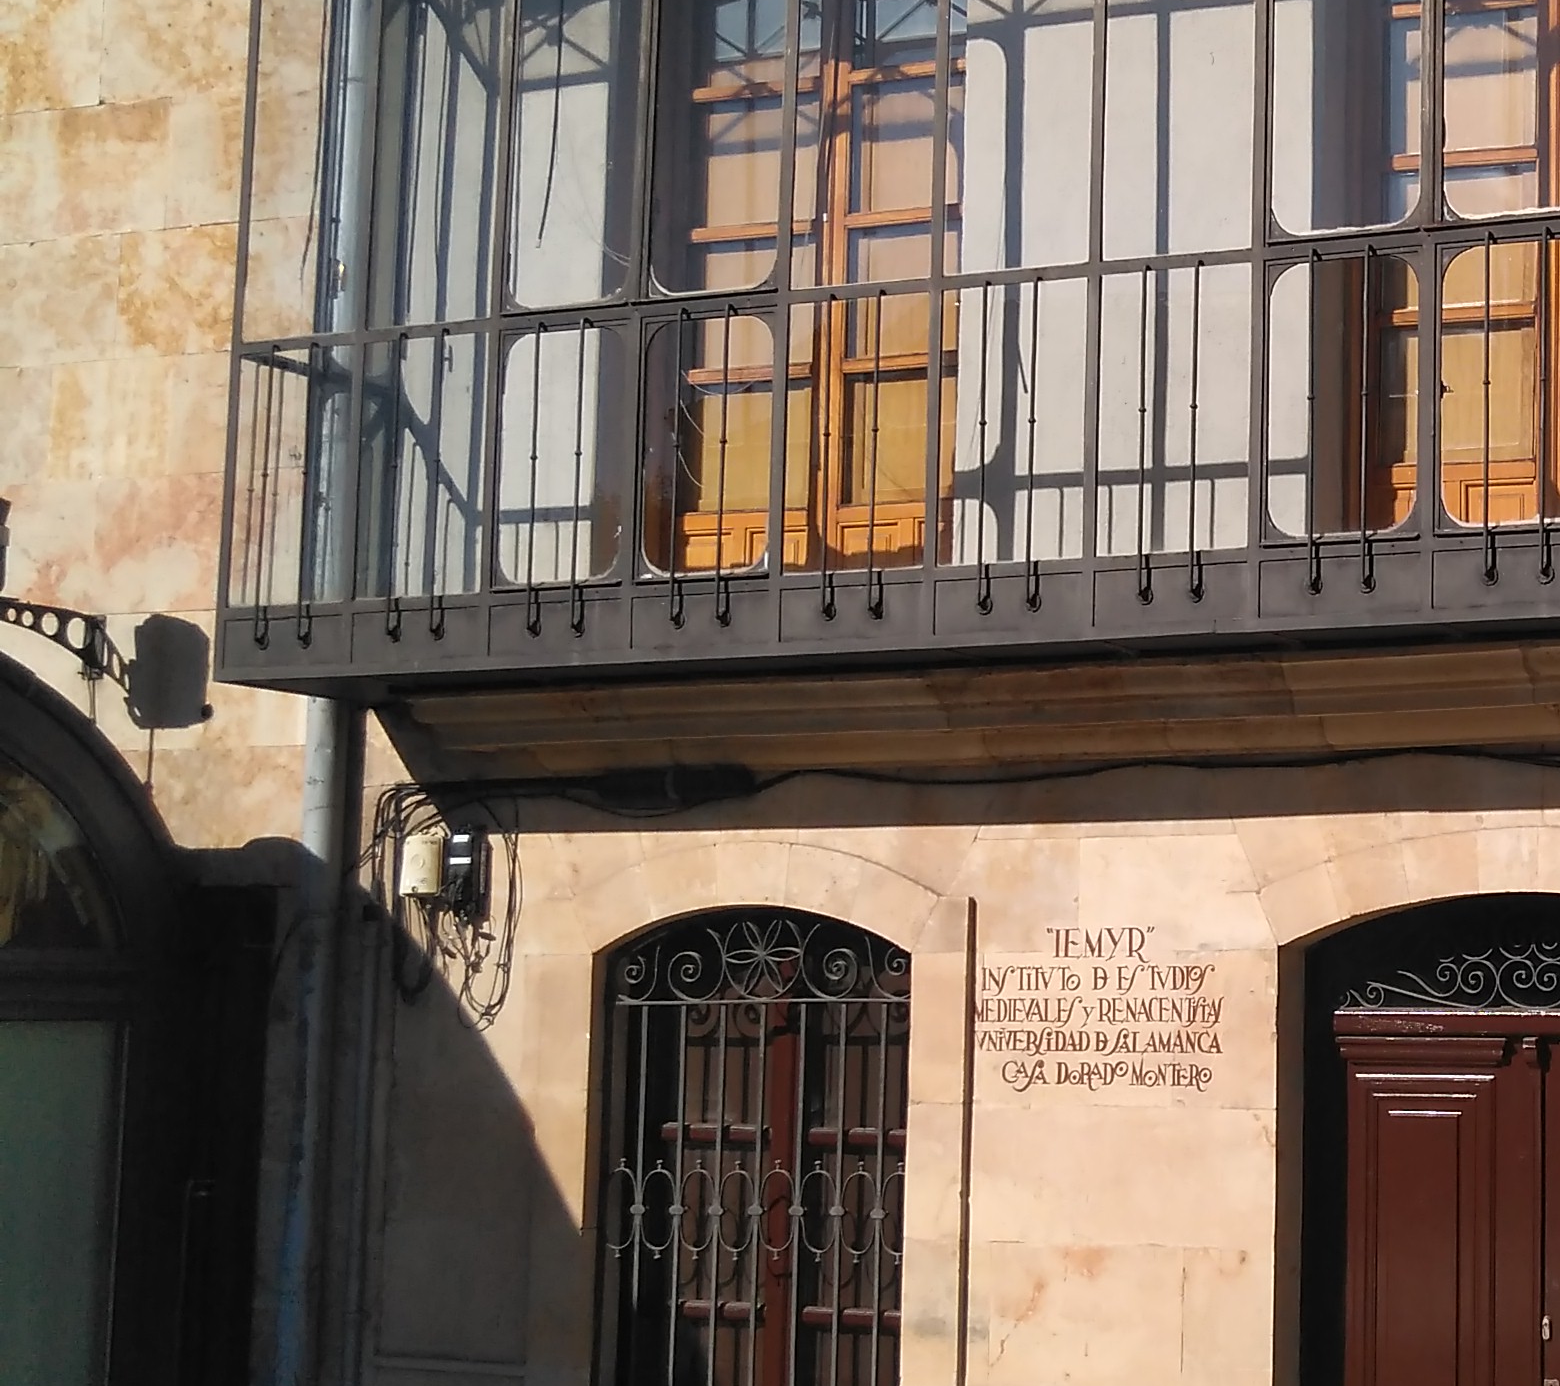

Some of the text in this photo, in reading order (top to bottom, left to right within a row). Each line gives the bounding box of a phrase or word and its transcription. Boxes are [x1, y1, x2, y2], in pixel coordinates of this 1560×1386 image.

[1106, 1028, 1223, 1055] SALAMANCA
[1002, 1059, 1212, 1092] CASA DORADO MONTERO
